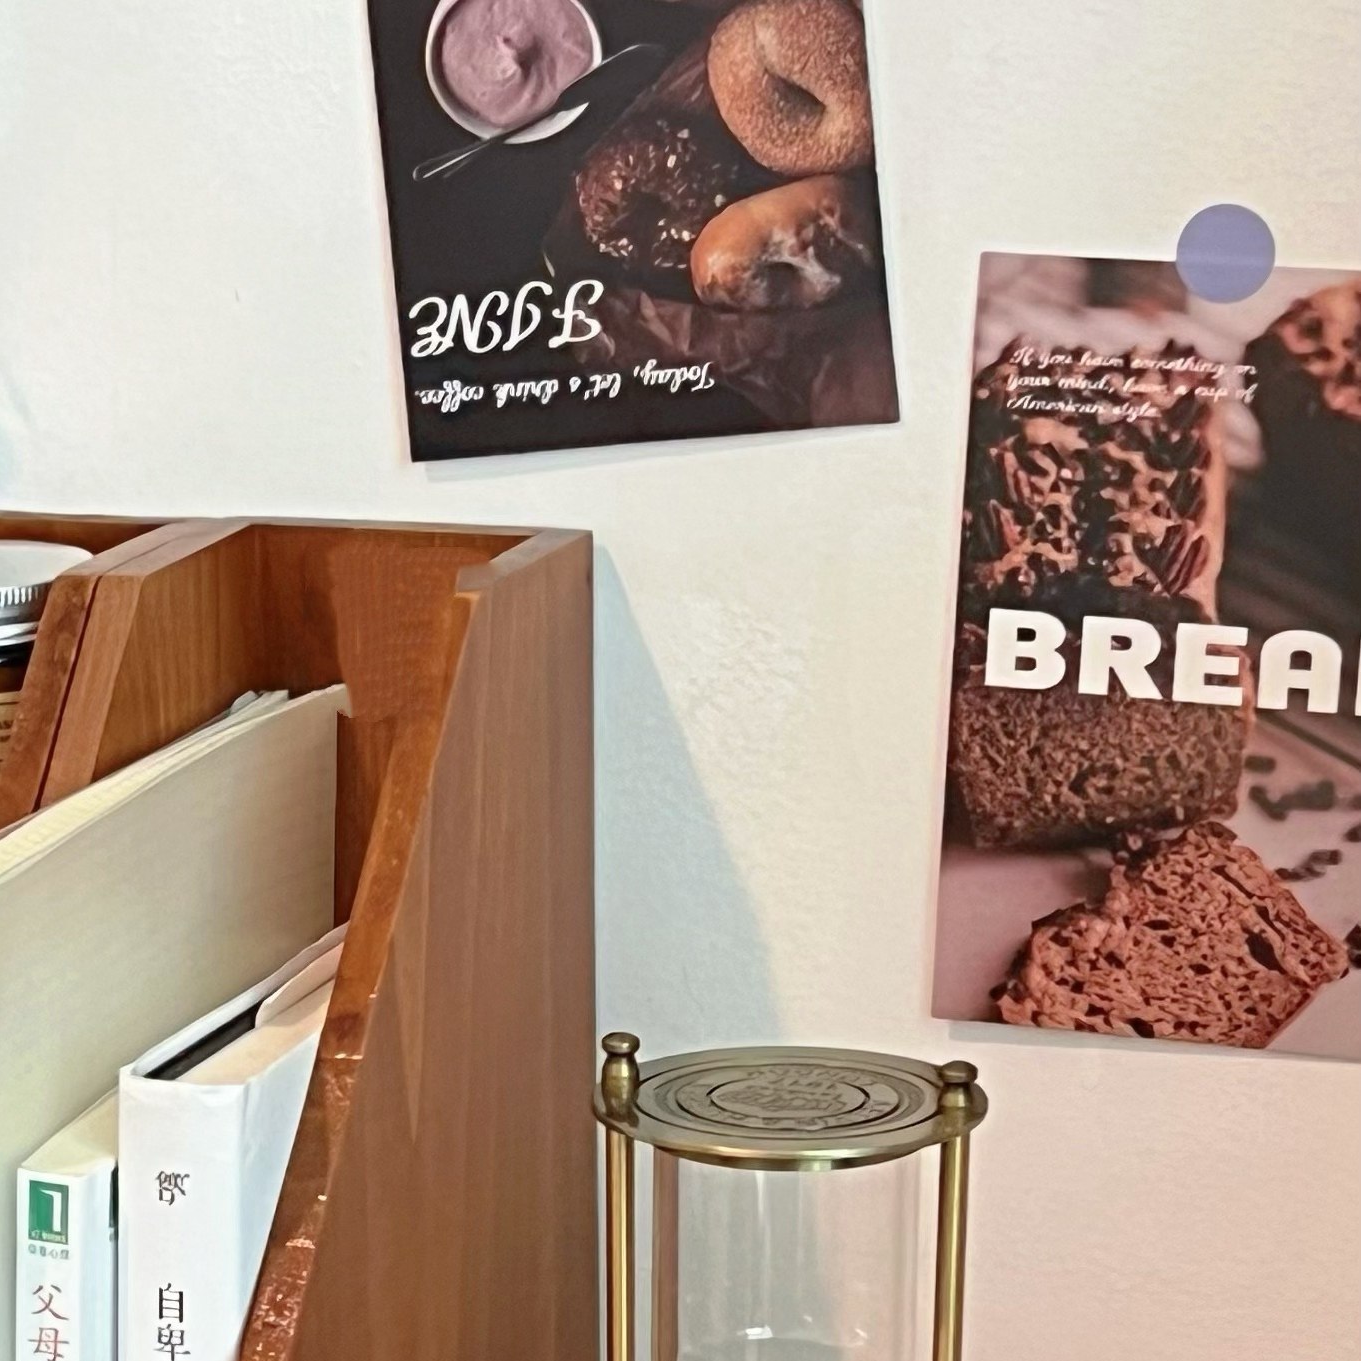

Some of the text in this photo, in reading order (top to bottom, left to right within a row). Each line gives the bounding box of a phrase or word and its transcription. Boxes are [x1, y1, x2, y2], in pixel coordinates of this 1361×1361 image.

[408, 279, 605, 358] FINE
[492, 377, 559, 408] drink
[633, 359, 715, 394] Today,
[984, 608, 1361, 717] BREA
